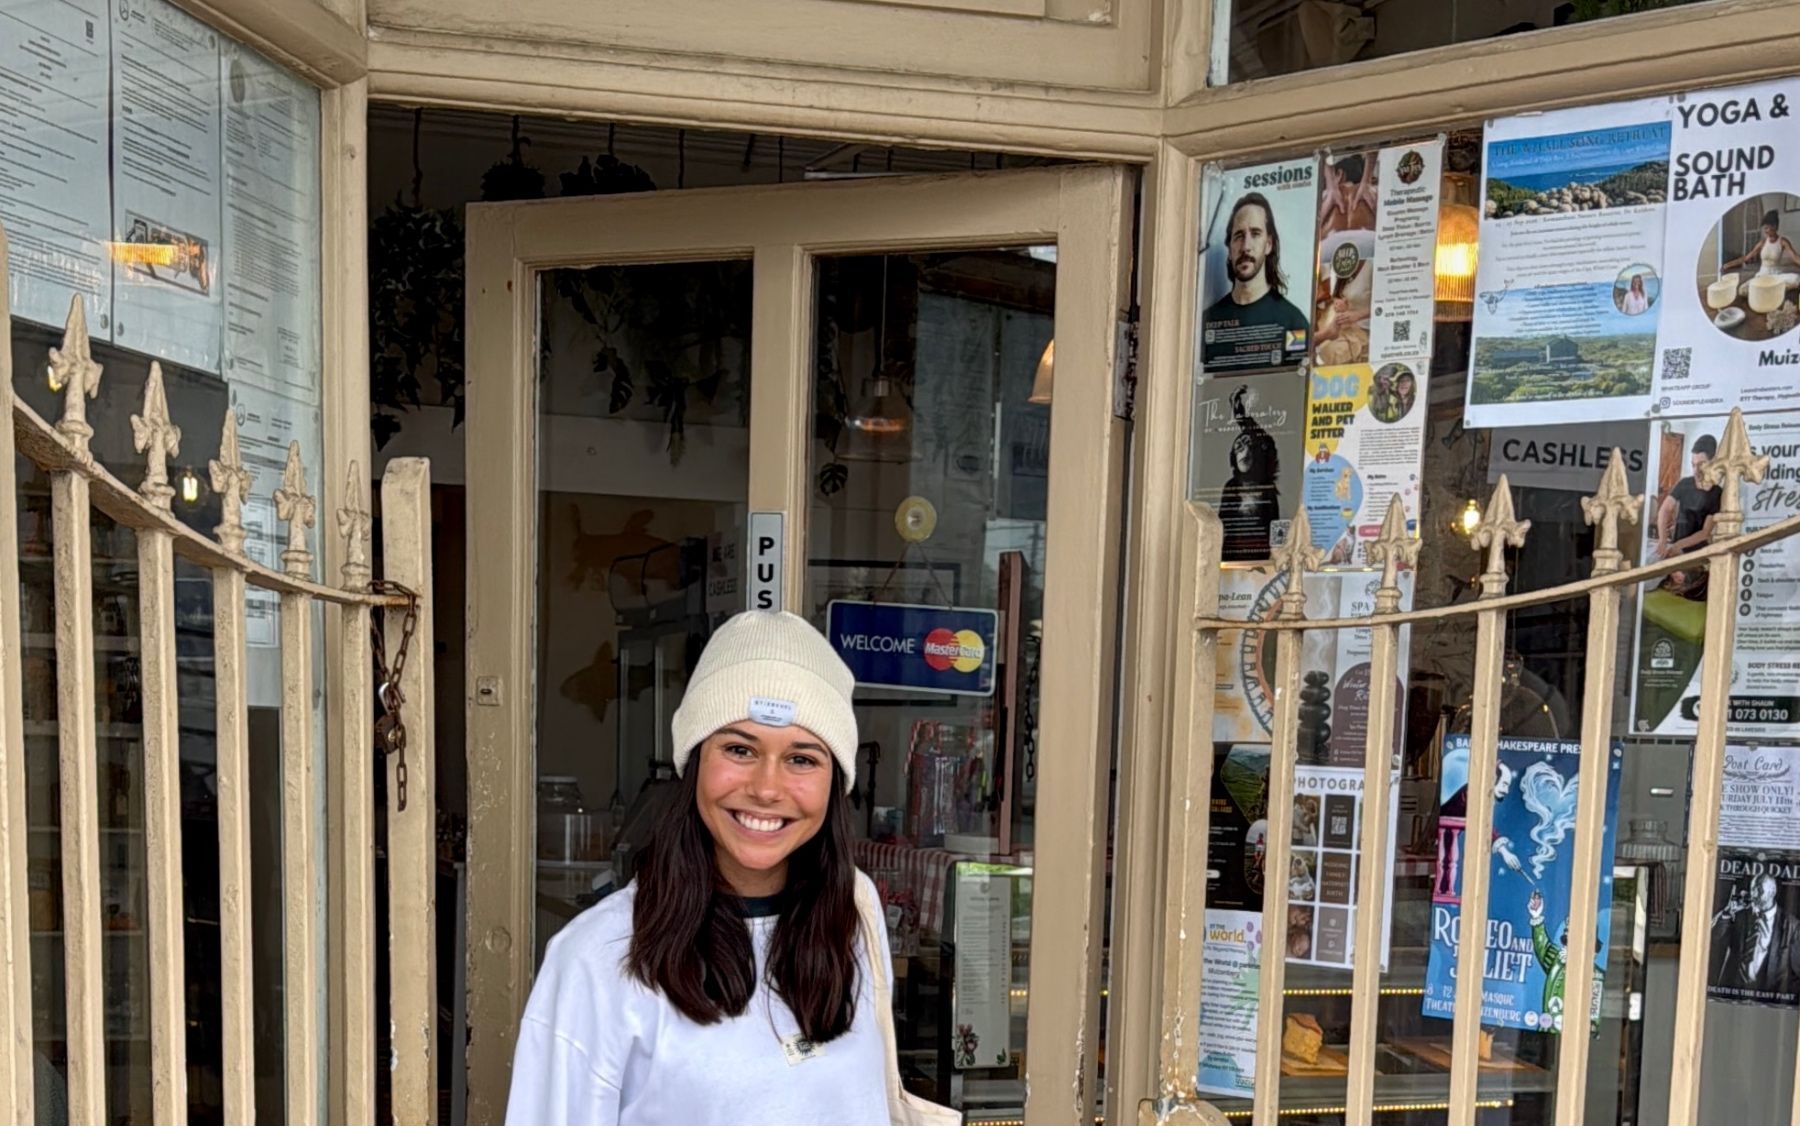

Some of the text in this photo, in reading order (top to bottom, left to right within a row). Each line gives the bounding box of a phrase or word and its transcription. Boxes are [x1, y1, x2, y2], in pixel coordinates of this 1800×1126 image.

[1677, 93, 1790, 129] YOGA &
[1673, 144, 1775, 177] SOUND
[1243, 164, 1313, 190] sessions
[1673, 172, 1746, 202] BATH
[1312, 373, 1361, 400] DOG
[1312, 402, 1354, 415] WALKER
[1311, 414, 1356, 427] AND PET
[1310, 428, 1345, 440] SITTER
[1502, 438, 1643, 472] CASHLES
[757, 536, 775, 610] PUS
[840, 633, 983, 660] WELCOME MasterCard
[1732, 699, 1775, 708] WITH SHAUN
[1735, 709, 1789, 721] 073 0130
[1498, 742, 1558, 753] HAKESPEARE
[1754, 755, 1784, 772] Card
[1730, 784, 1795, 796] SHOW ONLY!
[1719, 859, 1764, 876] DEAD
[1433, 906, 1534, 953] ROEO AND
[1732, 987, 1740, 995] IS
[1740, 988, 1755, 997] THE
[1755, 989, 1774, 998] EASY
[1776, 993, 1796, 1001] PART
